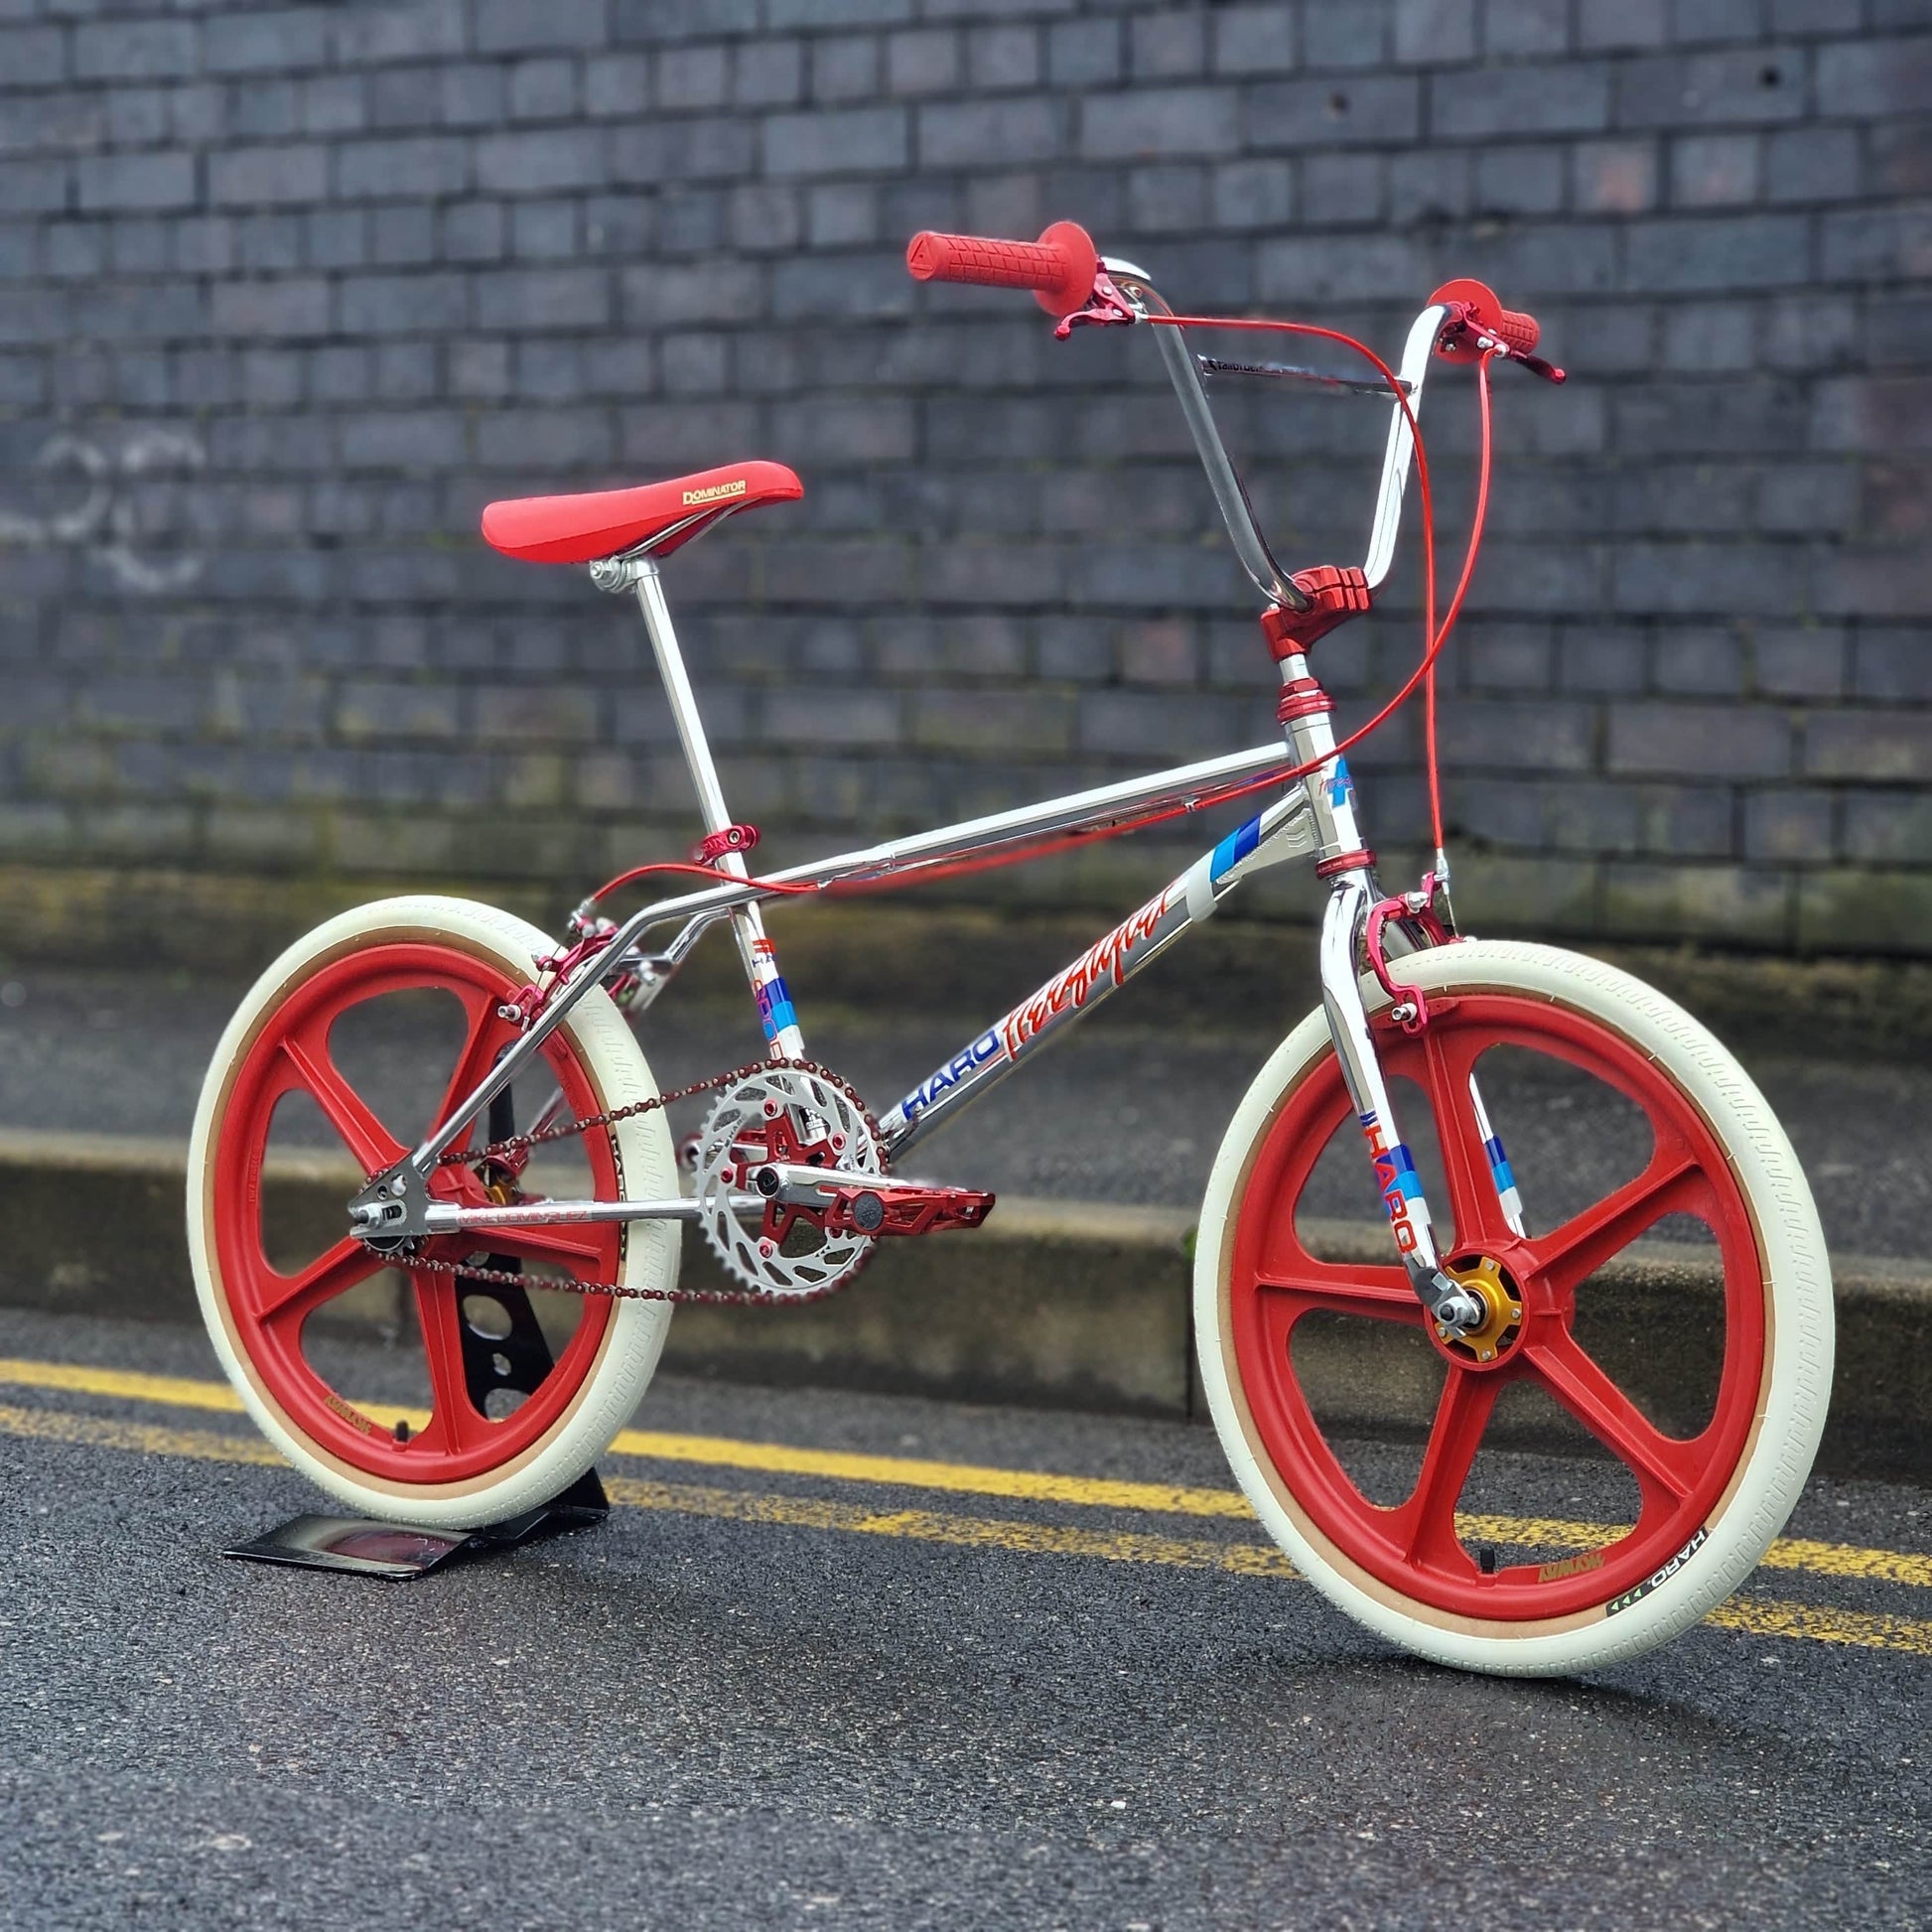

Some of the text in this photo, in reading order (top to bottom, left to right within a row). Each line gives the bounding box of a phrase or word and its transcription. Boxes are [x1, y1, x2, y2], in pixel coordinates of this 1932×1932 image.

[682, 481, 746, 505] DOMINATOR
[901, 1030, 1000, 1121] HARO
[1364, 1124, 1418, 1255] HARO
